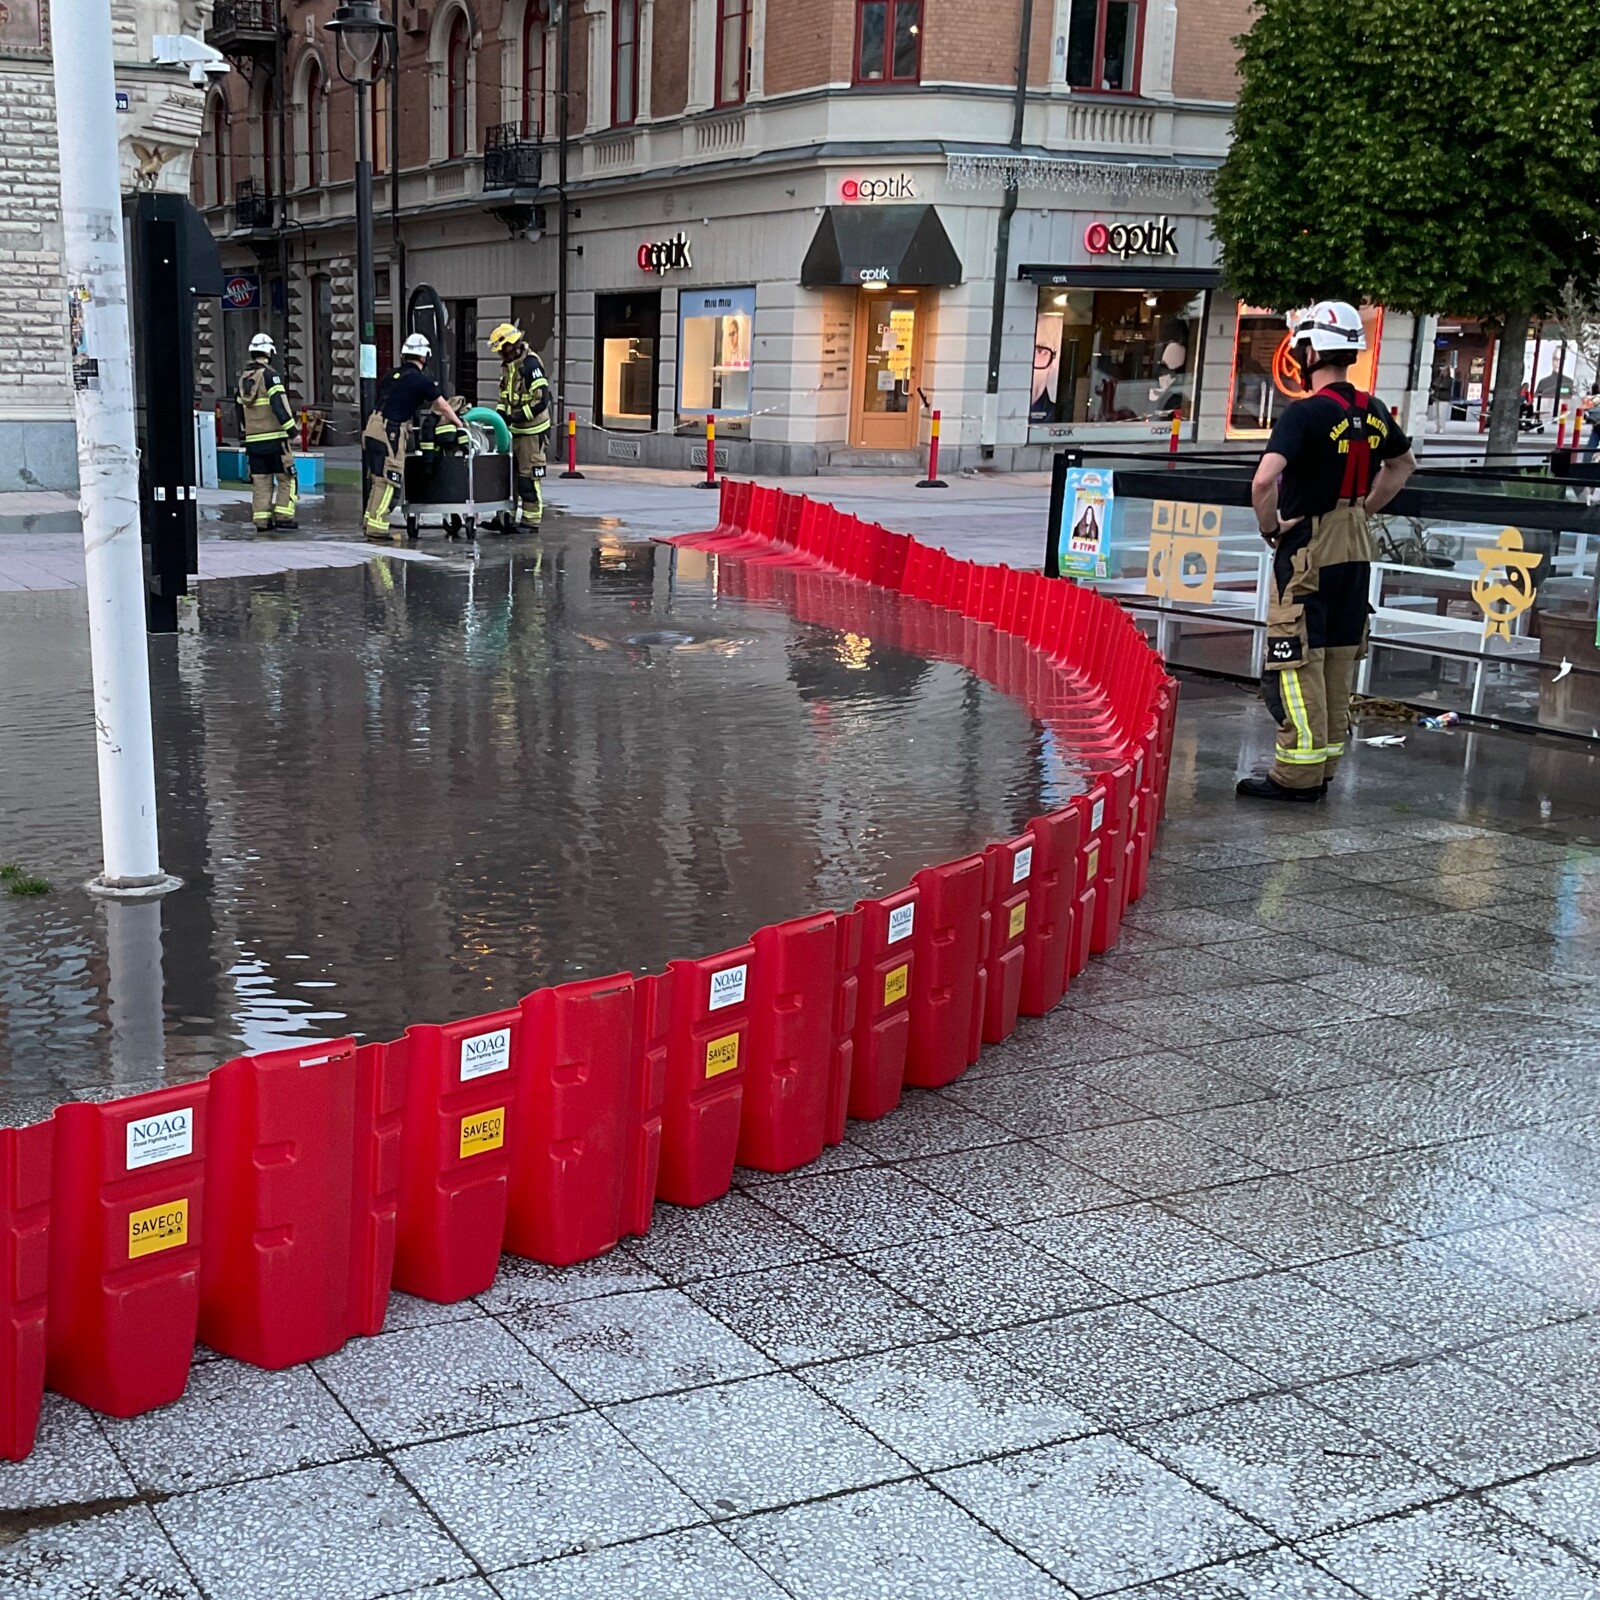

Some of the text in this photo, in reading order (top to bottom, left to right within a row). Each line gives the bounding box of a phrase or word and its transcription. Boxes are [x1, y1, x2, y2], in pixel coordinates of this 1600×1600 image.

[714, 970, 743, 990] NOAQ
[466, 1034, 506, 1058] NOAQ
[708, 1042, 736, 1061] SAVECO
[132, 1115, 187, 1142] NOAQ
[463, 1117, 501, 1139] SAVECO
[132, 1211, 183, 1236] SAVECO
